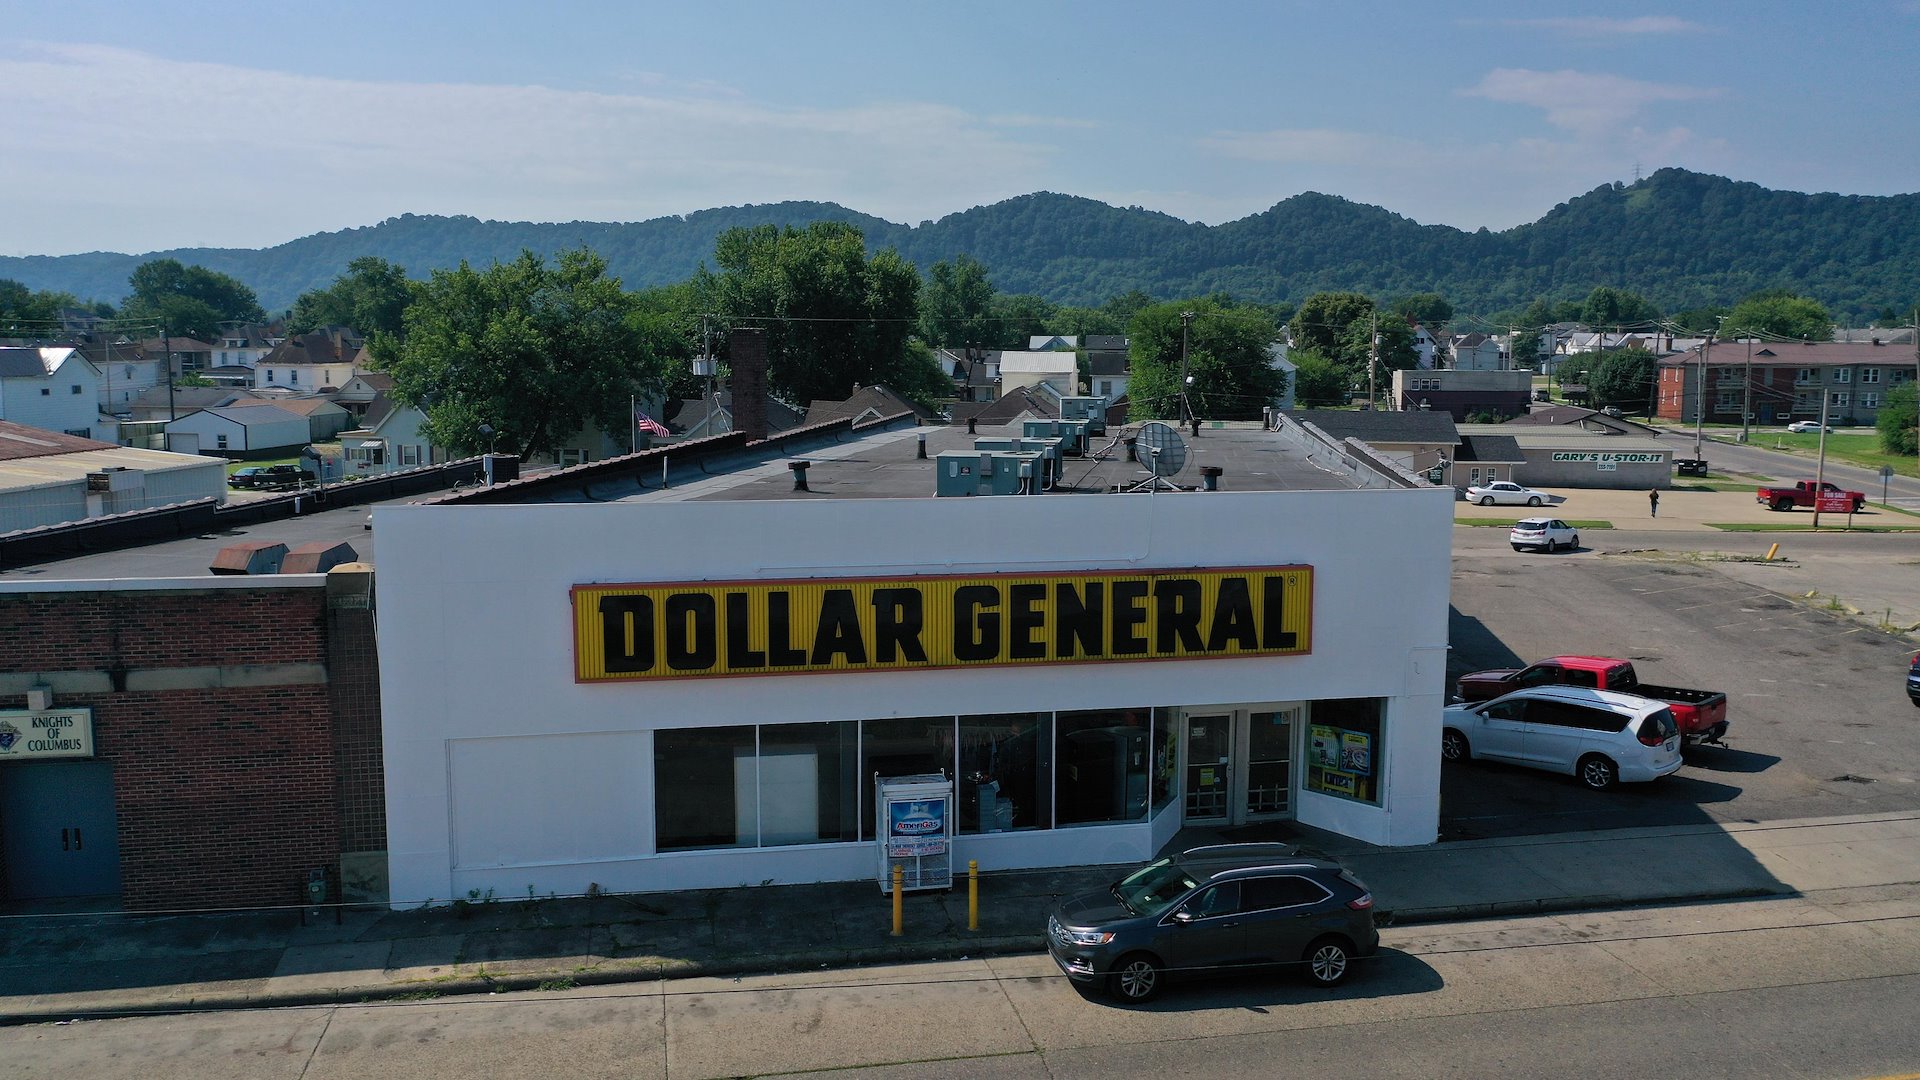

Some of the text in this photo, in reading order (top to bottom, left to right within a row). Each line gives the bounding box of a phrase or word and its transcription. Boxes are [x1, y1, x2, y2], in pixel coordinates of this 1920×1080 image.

[1553, 452, 1662, 462] GARY'S U-STOR-IT
[599, 576, 1297, 673] DOLLAR GENERAL
[32, 716, 73, 728] KNIGHTS
[47, 728, 61, 739] OF
[28, 739, 82, 751] COLUMBUS
[897, 821, 938, 830] AmeriGas
